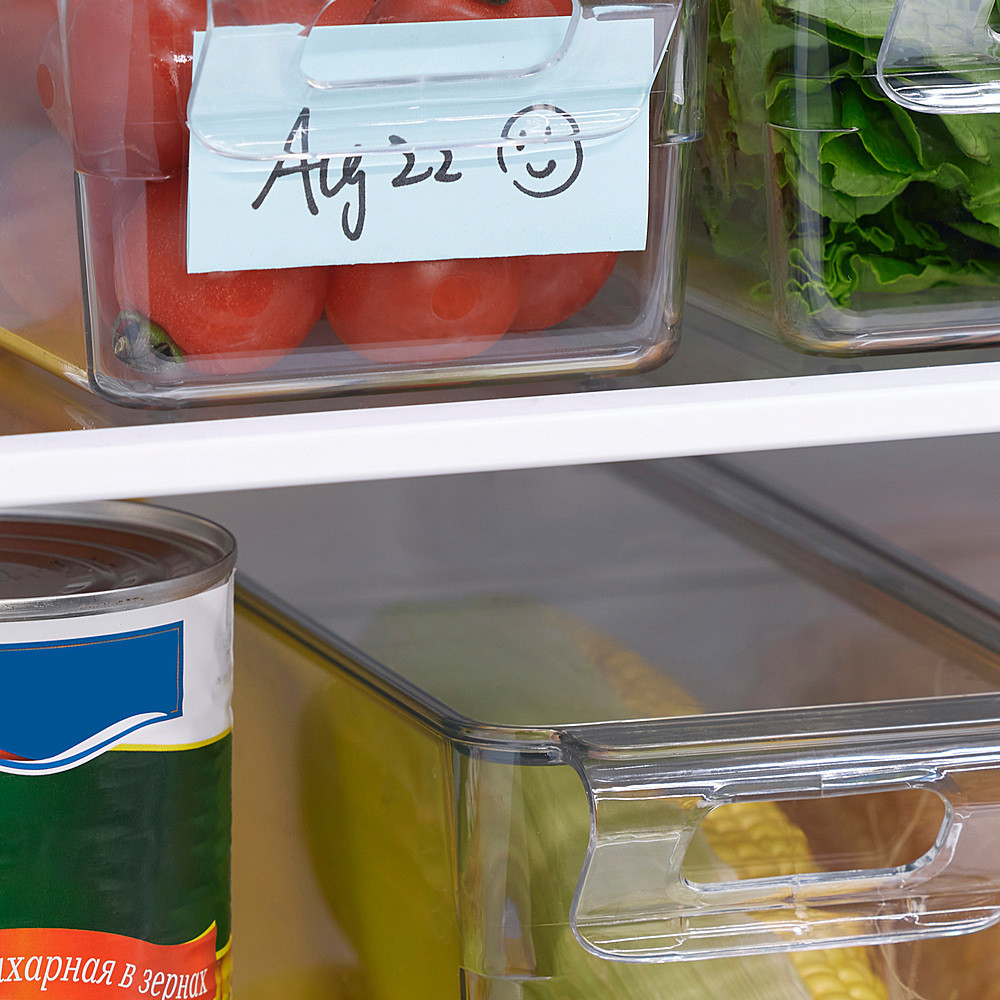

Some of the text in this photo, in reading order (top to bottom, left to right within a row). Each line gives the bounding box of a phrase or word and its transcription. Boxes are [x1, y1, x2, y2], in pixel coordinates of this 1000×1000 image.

[251, 106, 463, 242] Aug 22
[138, 967, 209, 1000] зернах
